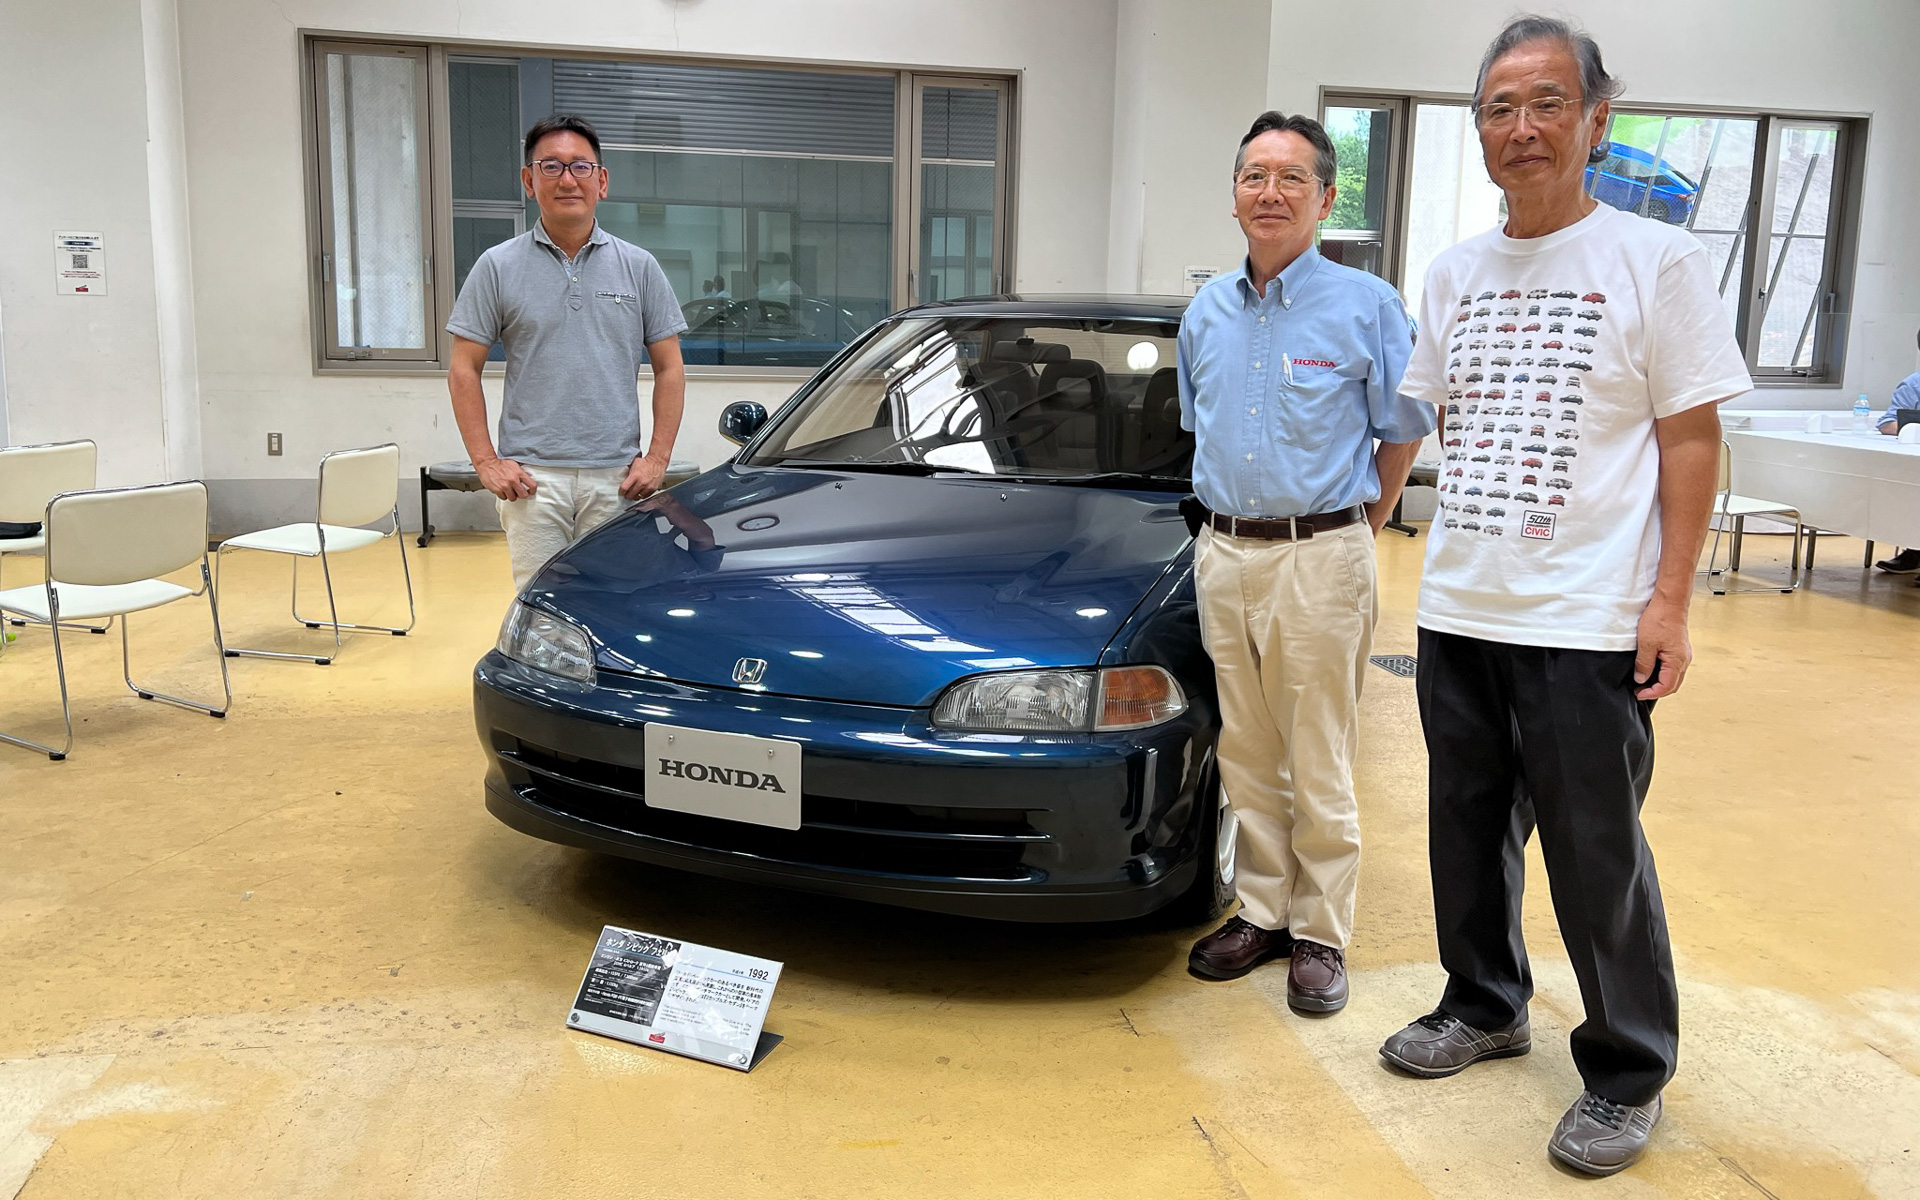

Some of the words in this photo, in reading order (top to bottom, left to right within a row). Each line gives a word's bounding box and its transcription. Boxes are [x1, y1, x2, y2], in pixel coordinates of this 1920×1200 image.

[1293, 358, 1335, 367] HONDA
[1525, 527, 1550, 536] CIVIC
[658, 758, 786, 793] HONDA
[605, 938, 626, 949] ホンダ
[748, 967, 769, 981] 1992
